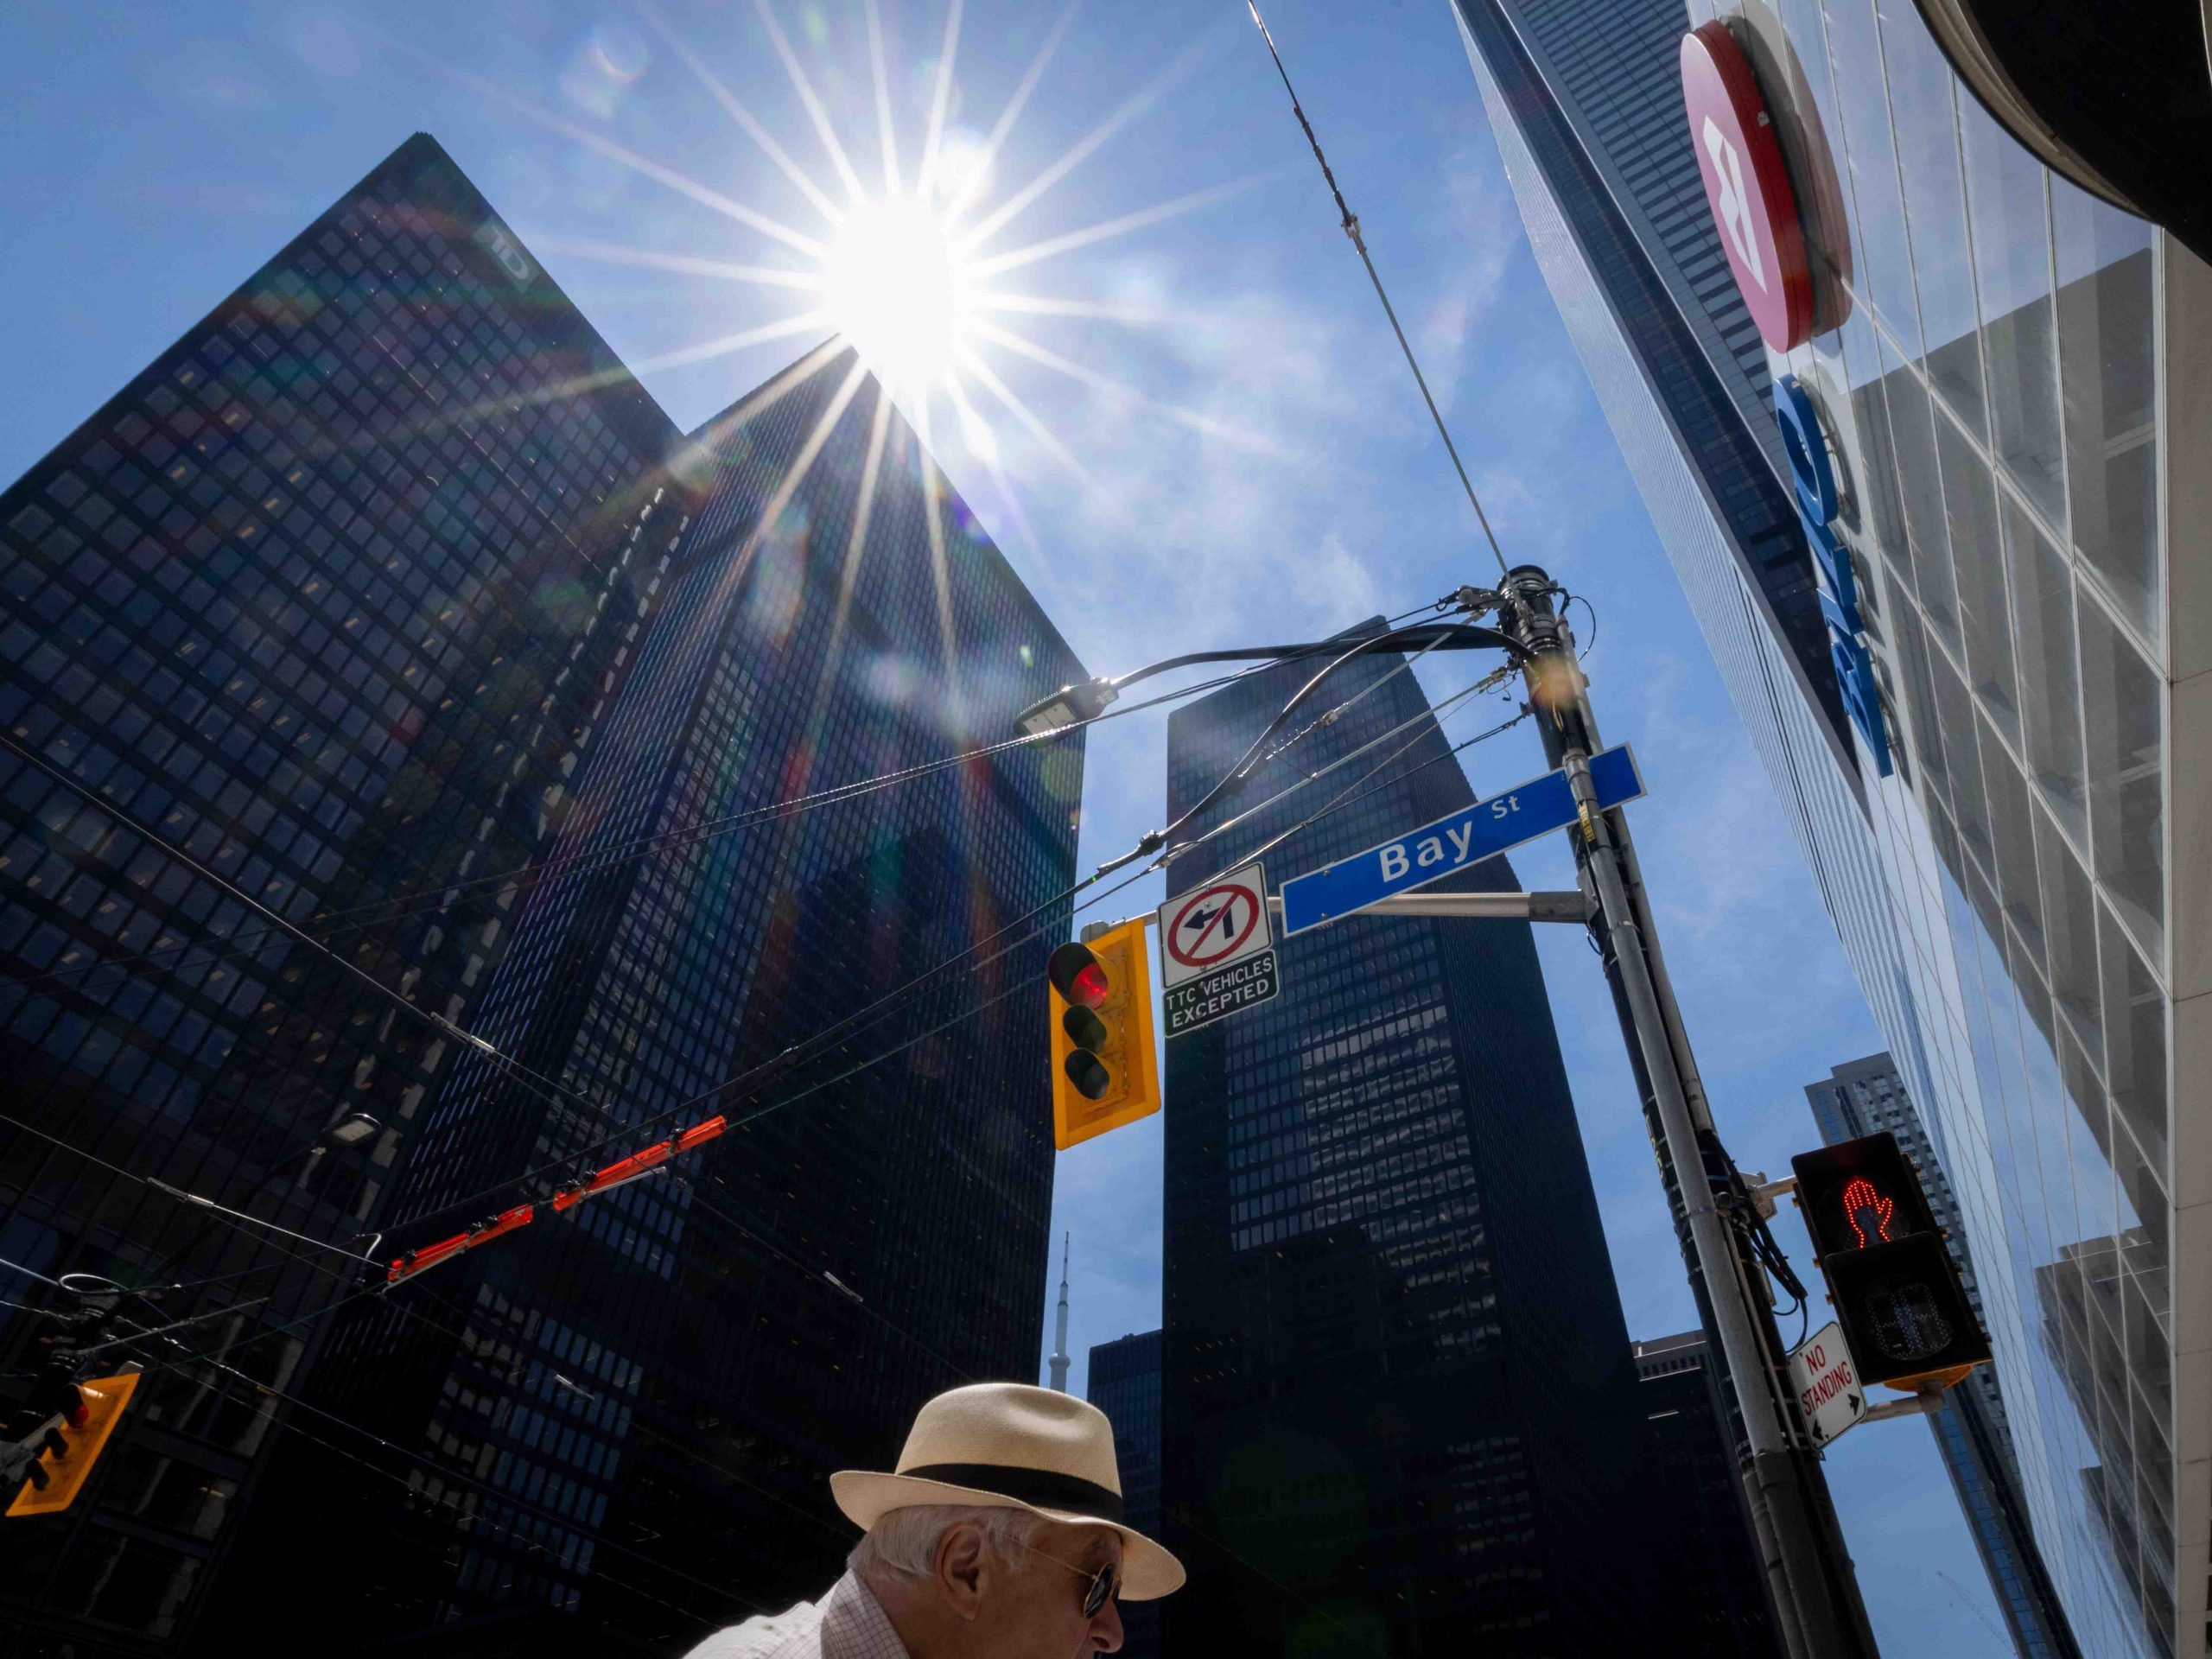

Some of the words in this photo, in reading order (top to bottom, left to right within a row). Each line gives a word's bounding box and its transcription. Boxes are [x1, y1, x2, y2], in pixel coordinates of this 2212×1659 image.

[1379, 820, 1473, 883] Bay
[1491, 795, 1521, 819] St
[1166, 988, 1197, 1010] TTC
[1200, 957, 1273, 996] VEHICLES
[1172, 978, 1269, 1028] EXCEPTED
[1806, 1344, 1826, 1376] NO
[1801, 1361, 1852, 1415] STANDING
